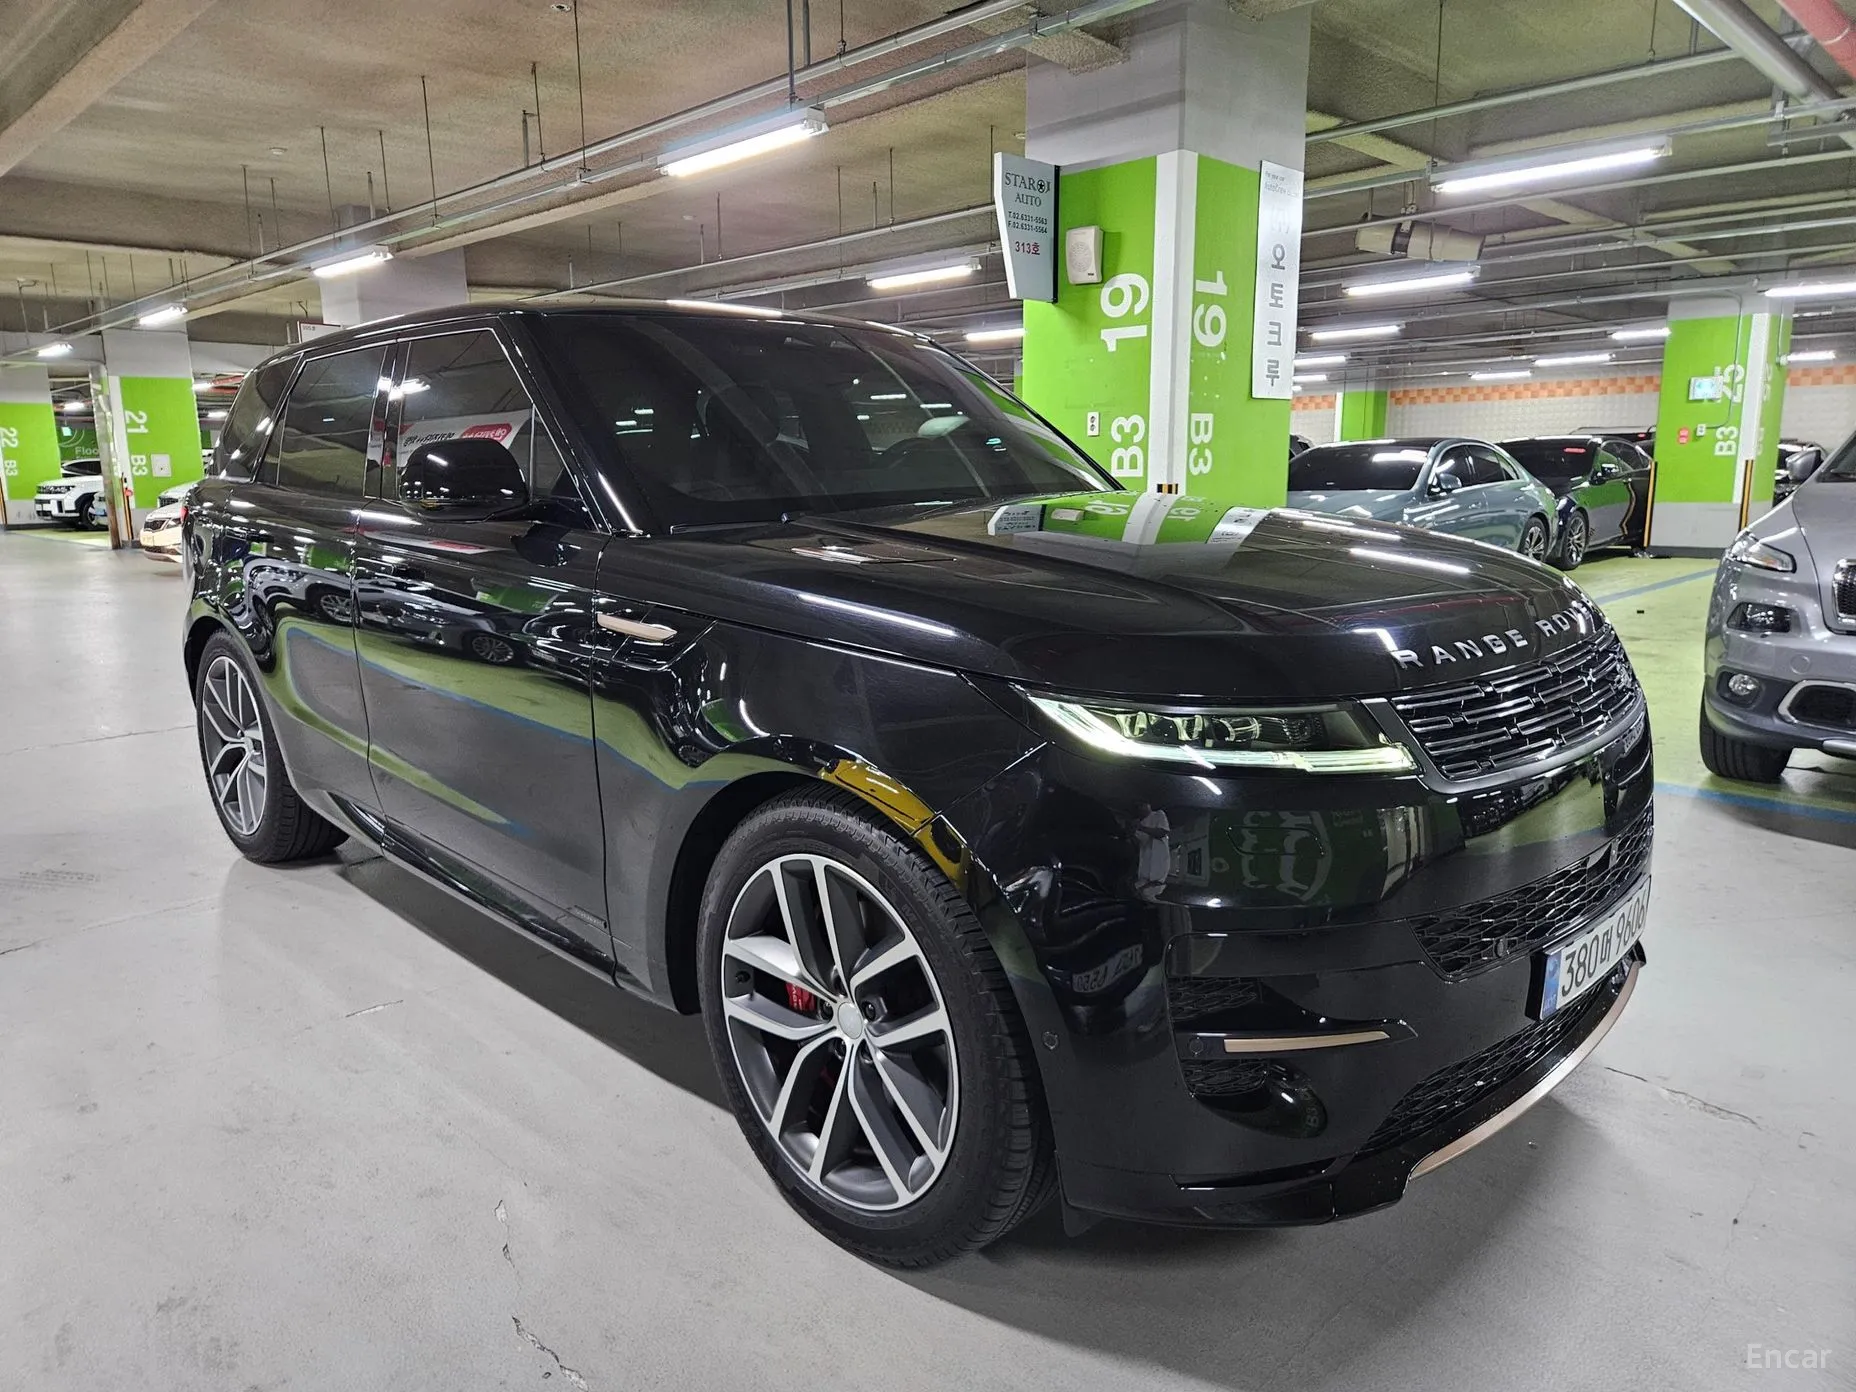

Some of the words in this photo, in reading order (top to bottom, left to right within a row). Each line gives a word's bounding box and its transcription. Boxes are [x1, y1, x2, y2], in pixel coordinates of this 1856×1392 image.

[1015, 193, 1042, 207] AUTO
[1015, 241, 1040, 255] 313호
[1101, 273, 1149, 352] 19
[1193, 271, 1227, 347] 19
[124, 410, 148, 434] 21
[0, 427, 18, 448] 22
[1111, 414, 1145, 477] B3
[1189, 413, 1214, 476] B3
[1714, 426, 1738, 456] B3
[4, 460, 18, 476] B3
[130, 455, 148, 476] B3
[1390, 629, 1528, 669] RANGE
[1535, 600, 1597, 637] ROV
[1616, 888, 1647, 955] 9606
